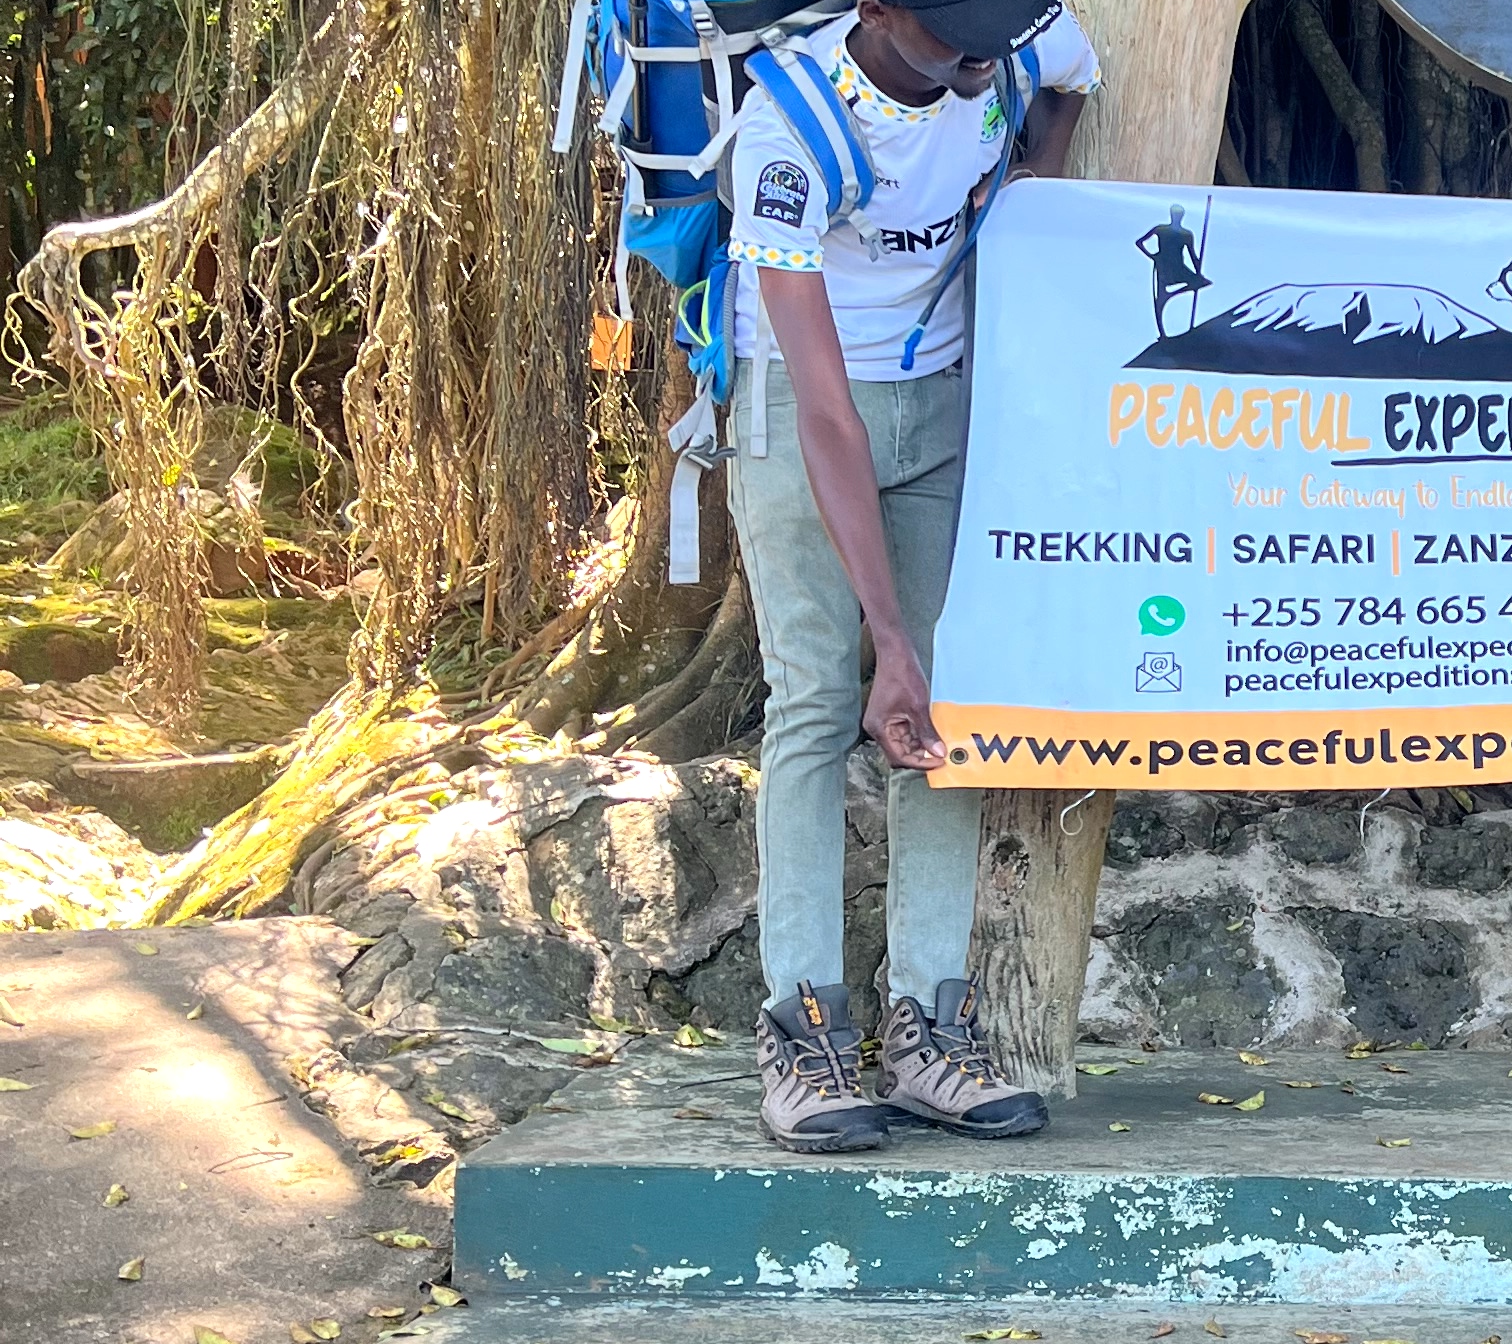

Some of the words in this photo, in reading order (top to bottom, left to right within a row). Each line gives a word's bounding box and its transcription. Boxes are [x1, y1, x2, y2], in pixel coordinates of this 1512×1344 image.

[1108, 382, 1371, 454] PEACEFUL
[1227, 470, 1289, 508] Your
[1299, 471, 1406, 519] Gateway
[1410, 478, 1439, 509] to
[988, 530, 1192, 563] TREKKING
[1233, 534, 1374, 564] SAFARI
[1222, 597, 1321, 627] +255
[1334, 596, 1406, 626] 784
[1416, 595, 1486, 625] 665
